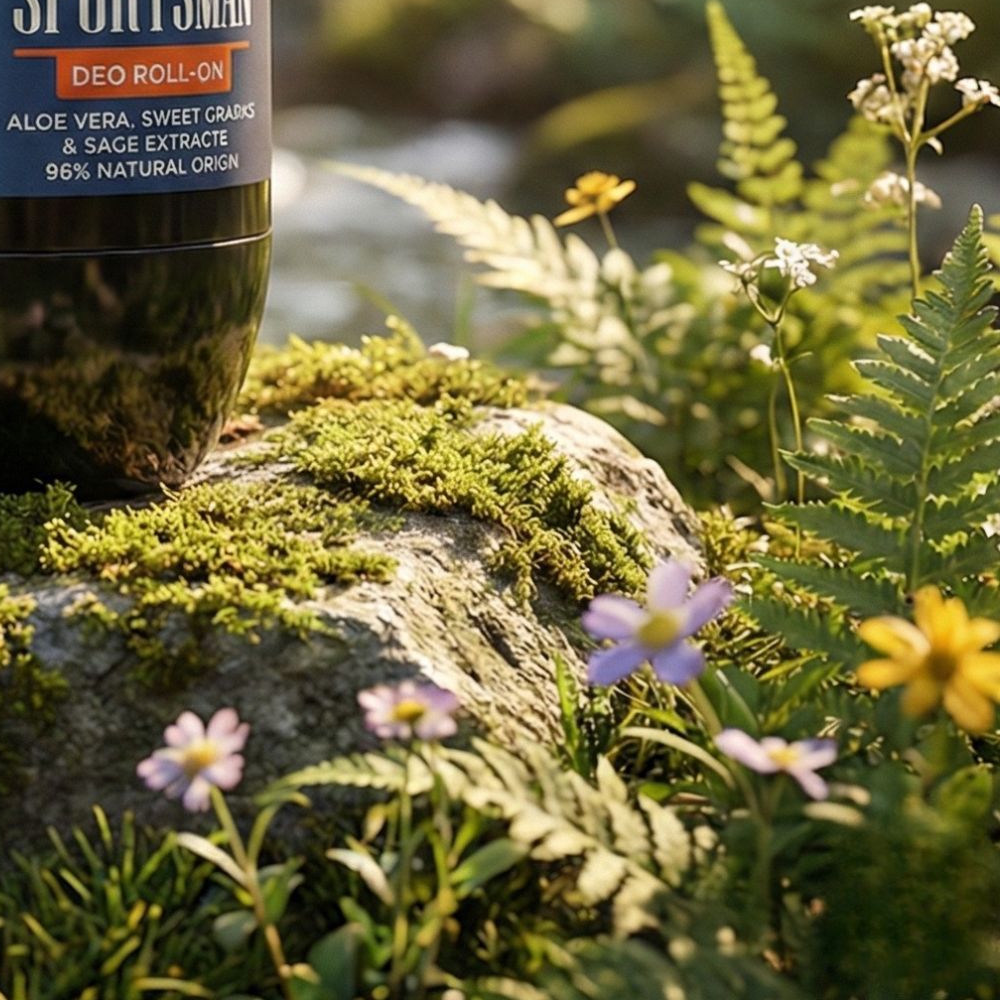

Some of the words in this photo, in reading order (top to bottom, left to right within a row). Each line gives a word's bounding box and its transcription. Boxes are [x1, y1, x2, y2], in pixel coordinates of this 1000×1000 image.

[71, 64, 127, 86] DEO
[133, 60, 225, 85] ROLL-ON
[6, 112, 68, 132] ALOE
[141, 106, 200, 128] SWEET
[62, 137, 78, 155] &
[83, 134, 140, 155] SAGE
[145, 129, 229, 153] EXTRACTE
[45, 162, 91, 181] 96%
[97, 158, 187, 180] NATURAL
[191, 152, 240, 174] ORIGN
